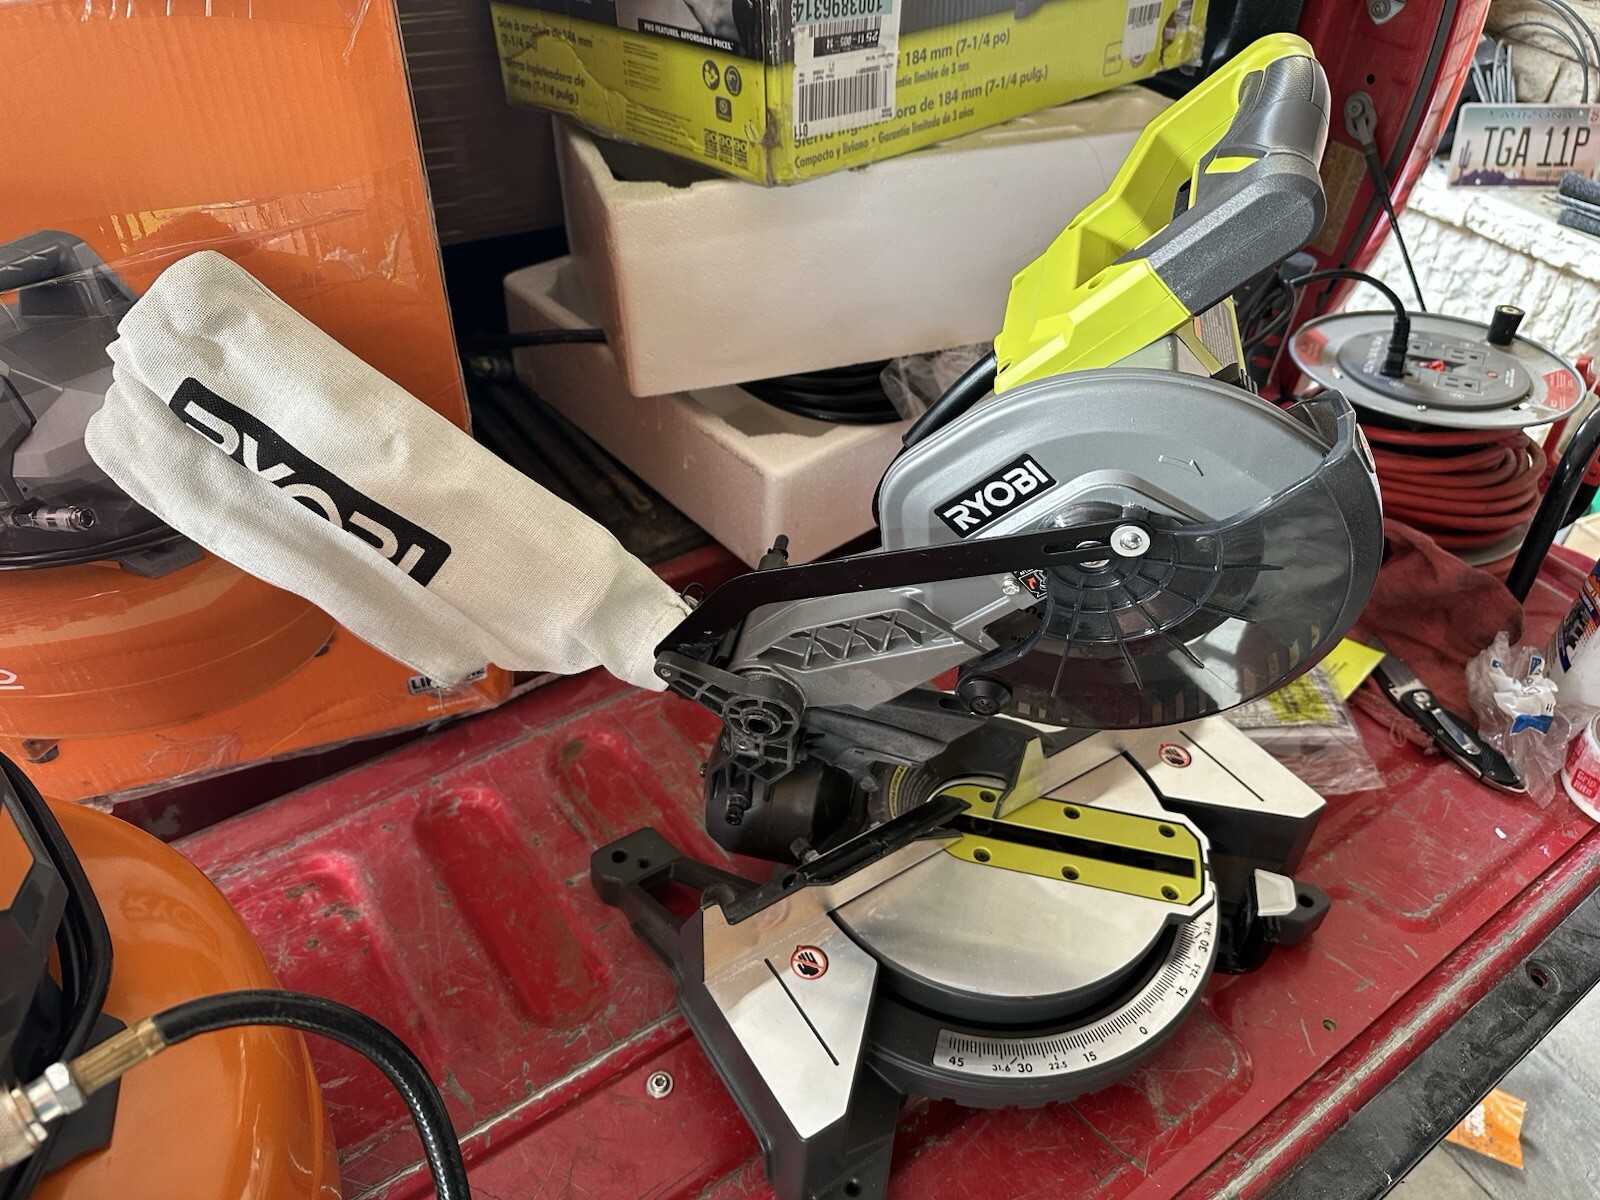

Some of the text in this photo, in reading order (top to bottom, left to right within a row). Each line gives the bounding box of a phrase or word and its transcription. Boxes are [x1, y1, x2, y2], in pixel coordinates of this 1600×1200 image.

[643, 22, 655, 32] PRO
[680, 30, 713, 47] AFFORDABLE
[905, 48, 927, 67] 184
[929, 44, 953, 61] mm
[955, 32, 991, 58] (7-1/4
[992, 28, 1011, 50] po)
[919, 96, 935, 112] de
[938, 89, 959, 108] 184
[961, 85, 983, 101] mm
[984, 72, 1017, 97] (7-1/4
[1018, 63, 1049, 88] pulg.)
[940, 64, 950, 77] de
[951, 62, 957, 75] 3
[957, 60, 970, 72] ans
[1499, 109, 1573, 120] ARIZONA
[794, 107, 975, 170] Compacto y liviano Garantía limitada de 3 años
[1482, 125, 1591, 167] TGA 11P
[942, 459, 1049, 533] RYOBI
[948, 919, 1213, 1074] 45 31.6 30 22.5 15 0 15 22.5 30 31.6
